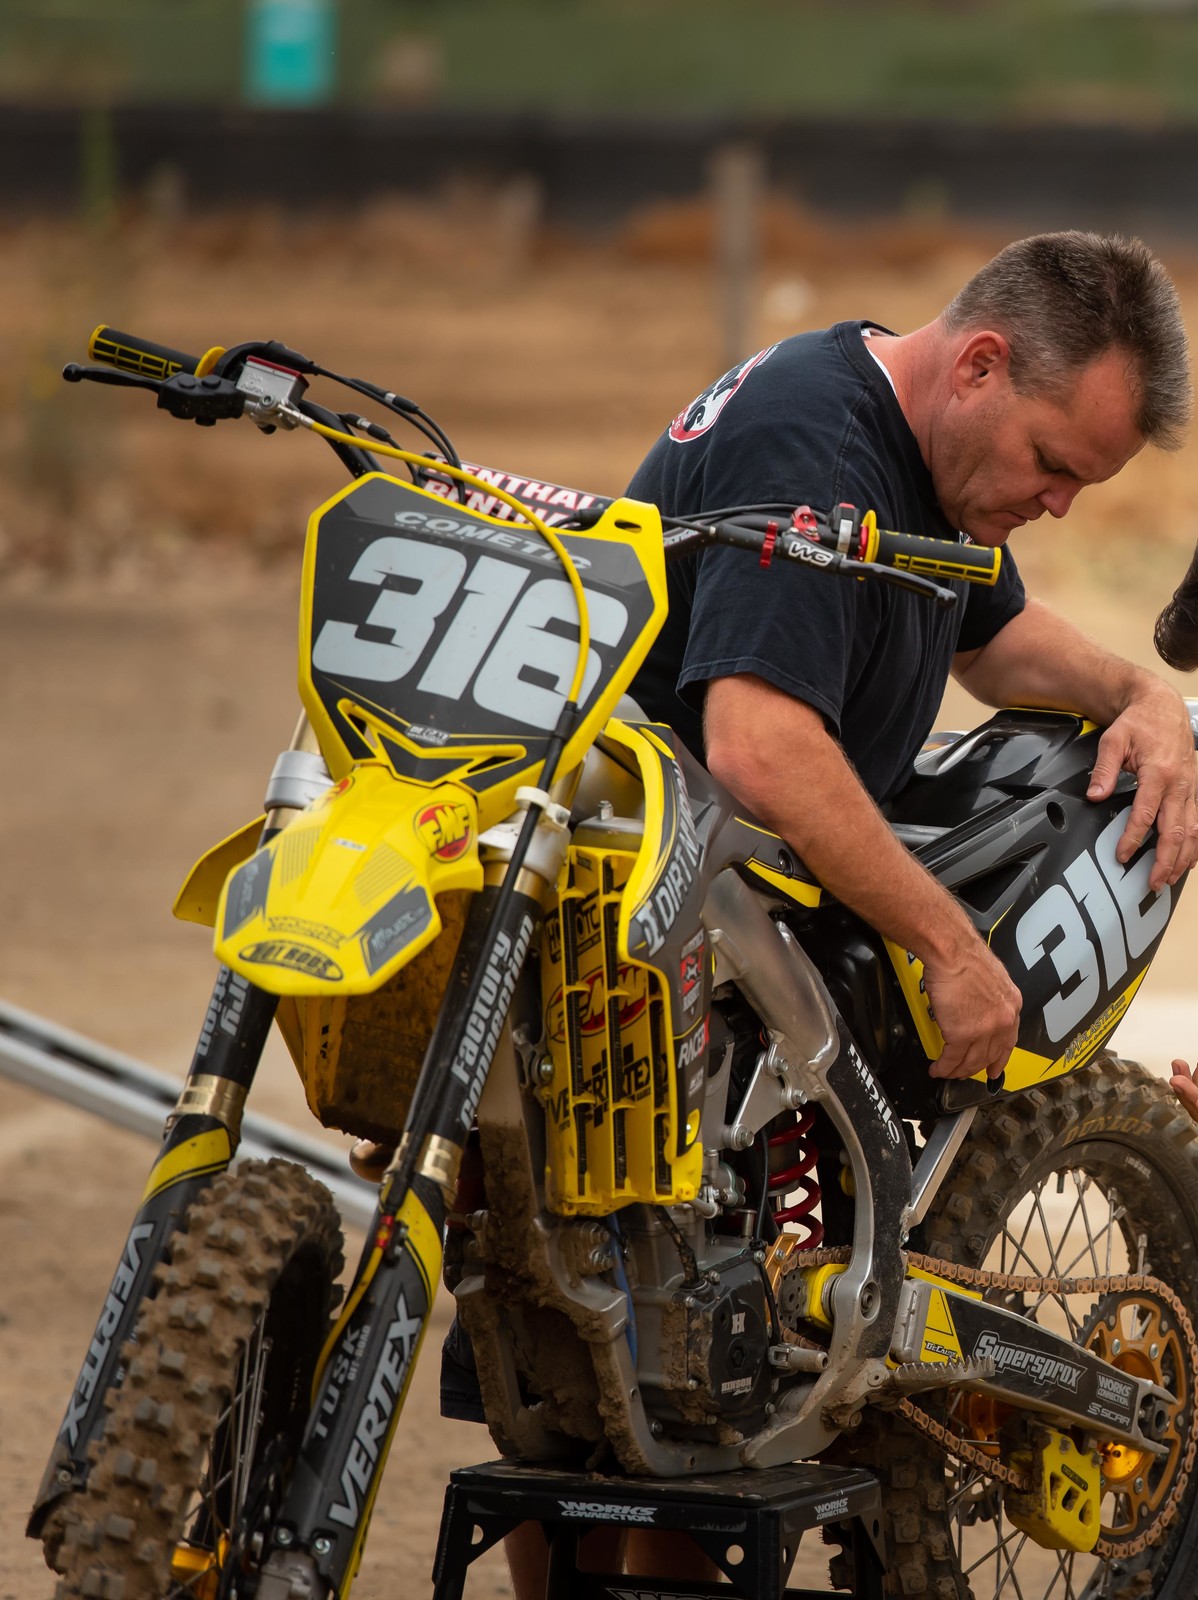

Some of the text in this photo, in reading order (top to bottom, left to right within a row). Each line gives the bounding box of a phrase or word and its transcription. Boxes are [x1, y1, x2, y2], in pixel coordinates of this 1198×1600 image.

[313, 536, 628, 731] 316
[416, 803, 471, 857] FMF
[1015, 805, 1172, 1043] 316
[451, 929, 512, 1085] Factory
[848, 1042, 900, 1144] nihilo
[60, 1223, 154, 1448] VERTEX
[975, 1333, 1085, 1388] Supersprox
[311, 1327, 361, 1439] TUSK
[1097, 1387, 1130, 1407] CONNECTION
[1098, 1374, 1133, 1396] WORKS
[328, 1293, 423, 1529] VERTEX
[1100, 1408, 1131, 1426] SCAR
[557, 1500, 658, 1516] WORKS
[560, 1510, 655, 1523] CONNECTION
[814, 1498, 849, 1514] WORKS
[816, 1507, 849, 1521] CONNECTION
